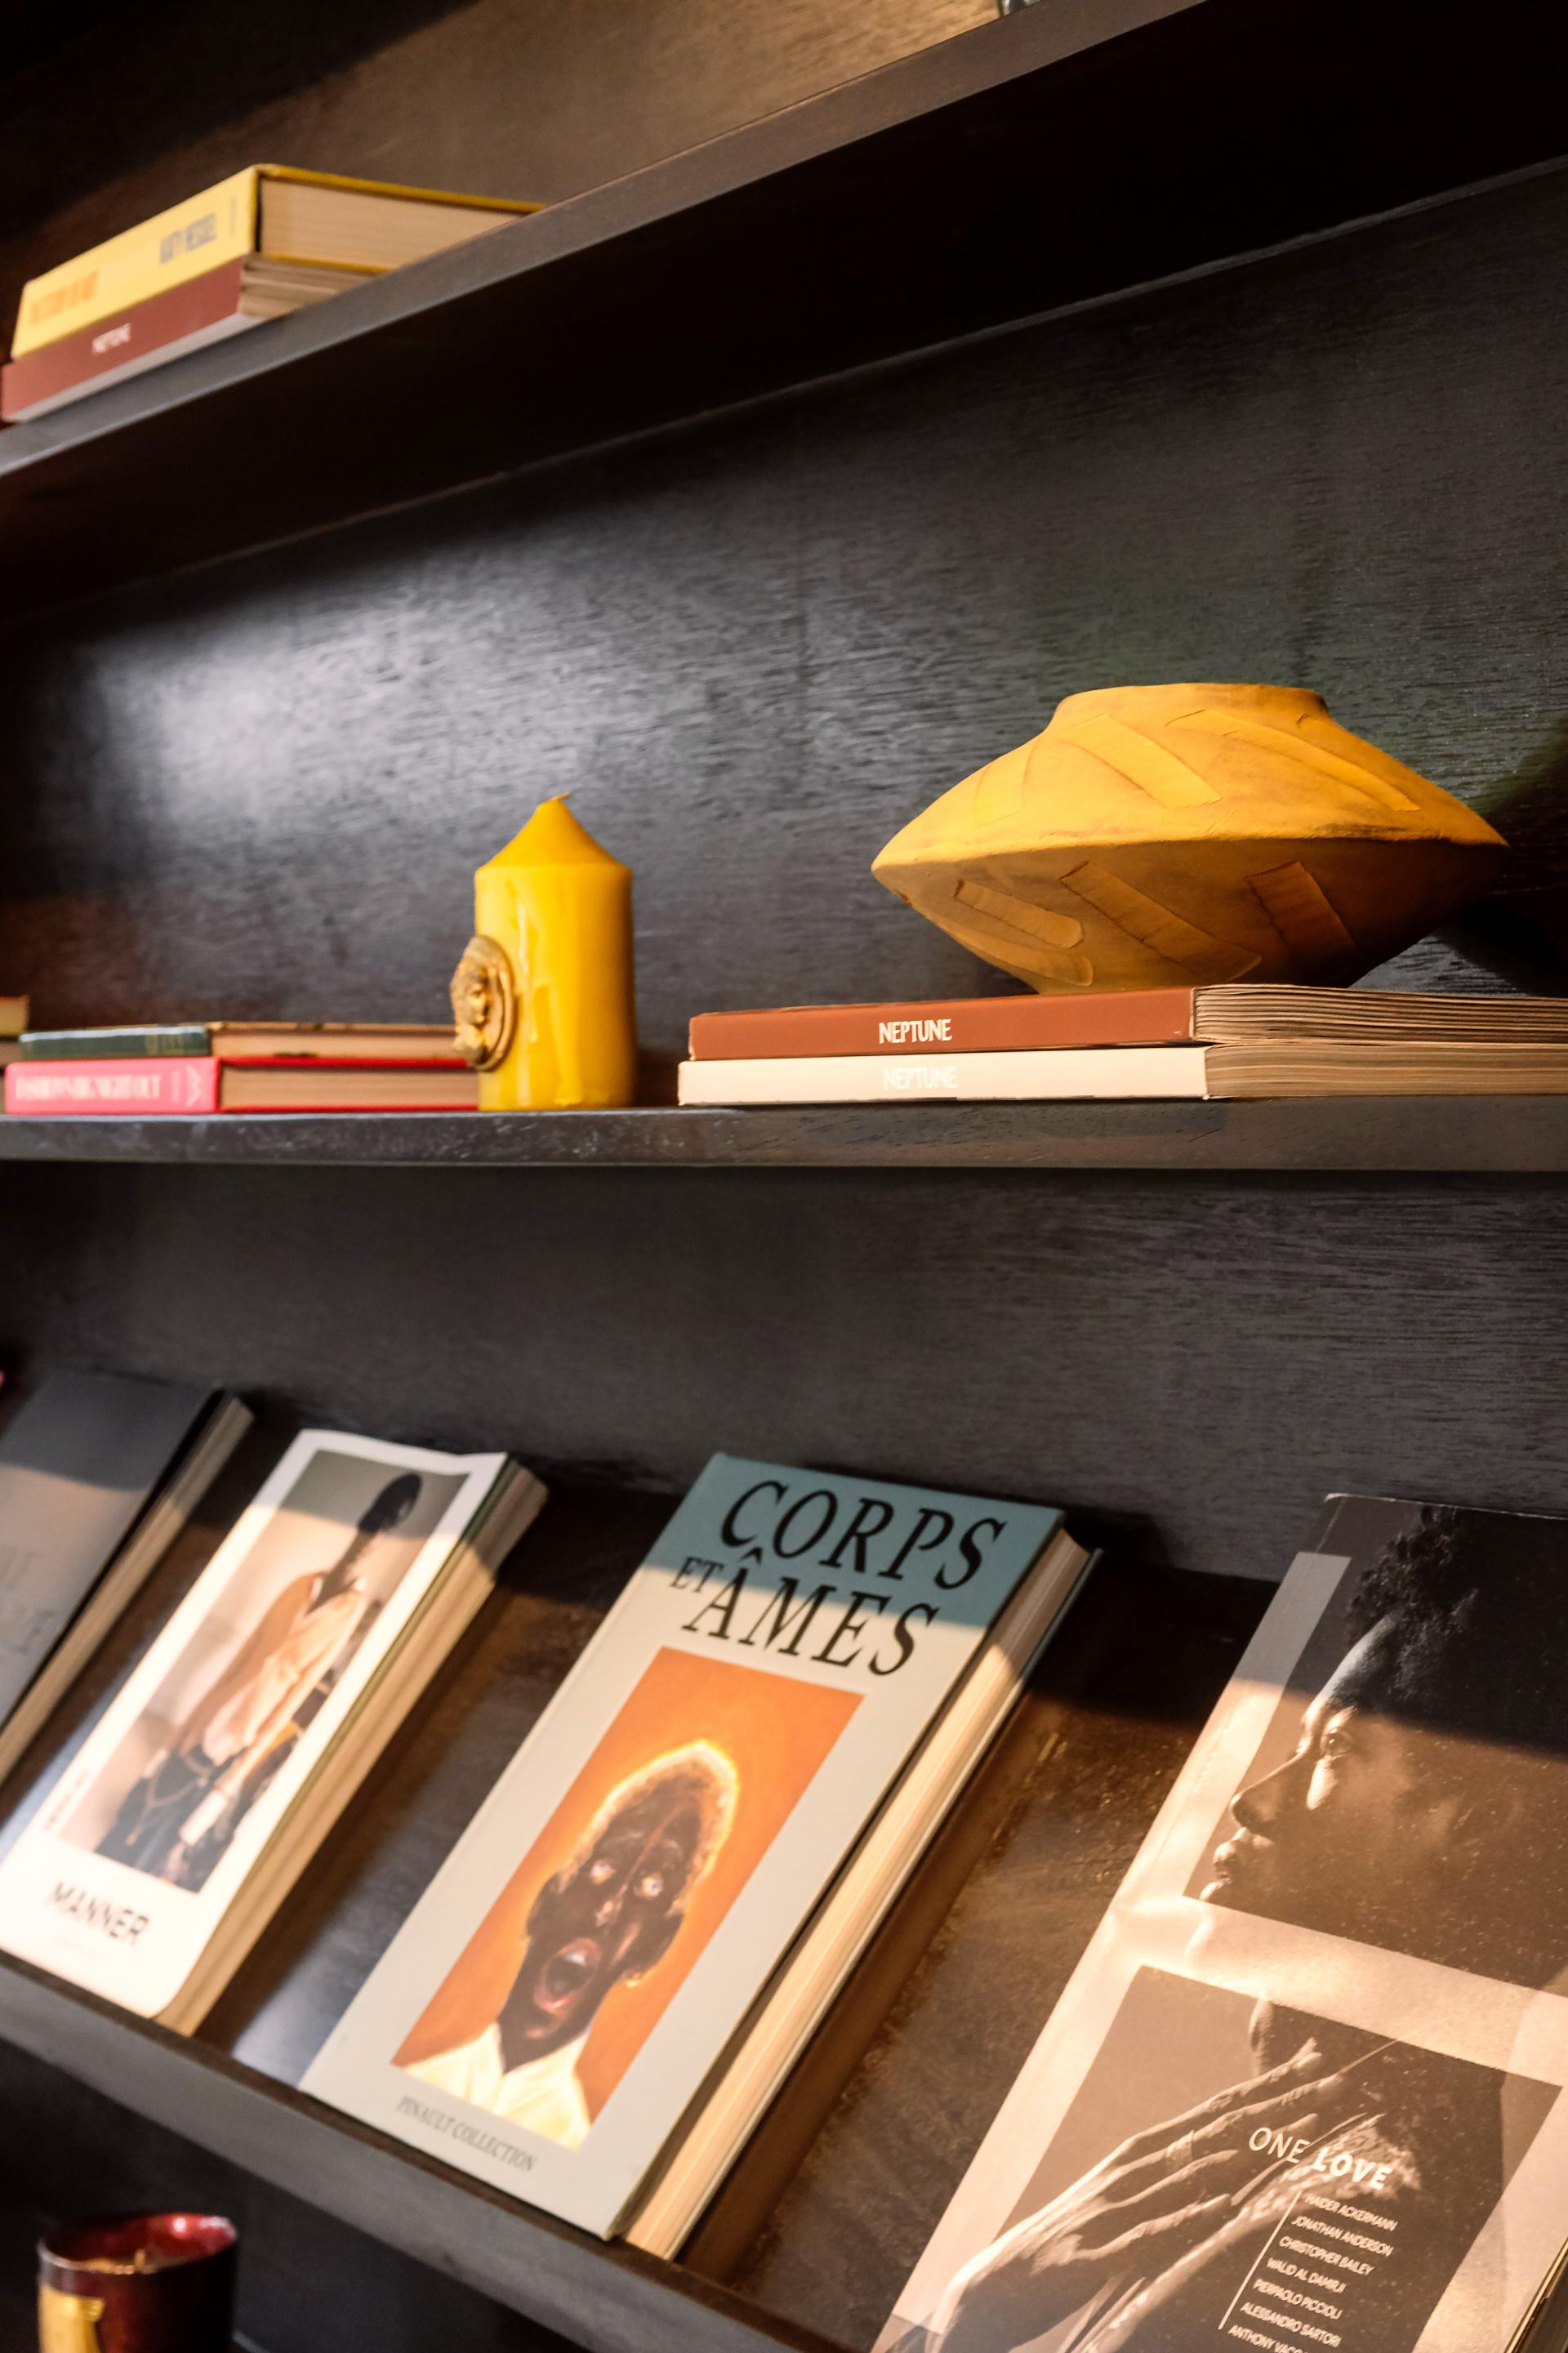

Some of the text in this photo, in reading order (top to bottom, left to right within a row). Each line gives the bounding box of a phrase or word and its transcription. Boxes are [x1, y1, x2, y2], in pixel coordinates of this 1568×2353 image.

[879, 1018, 952, 1044] NEPTUNE
[883, 1066, 959, 1090] NEPTUNE
[720, 1480, 1008, 1590] CORPS
[670, 1546, 940, 1676] ET ÂMES
[452, 2121, 539, 2173] COLLECTION
[1249, 2127, 1393, 2190] ONE LOVE
[1279, 2235, 1375, 2275] CHRISTOPHER BAILEY
[1290, 2215, 1395, 2257] JONATHAN ANDERSON
[1294, 2268, 1309, 2281] AL
[1227, 2324, 1277, 2350] ANTHONY
[1240, 2302, 1303, 2333] ALESSANDRO
